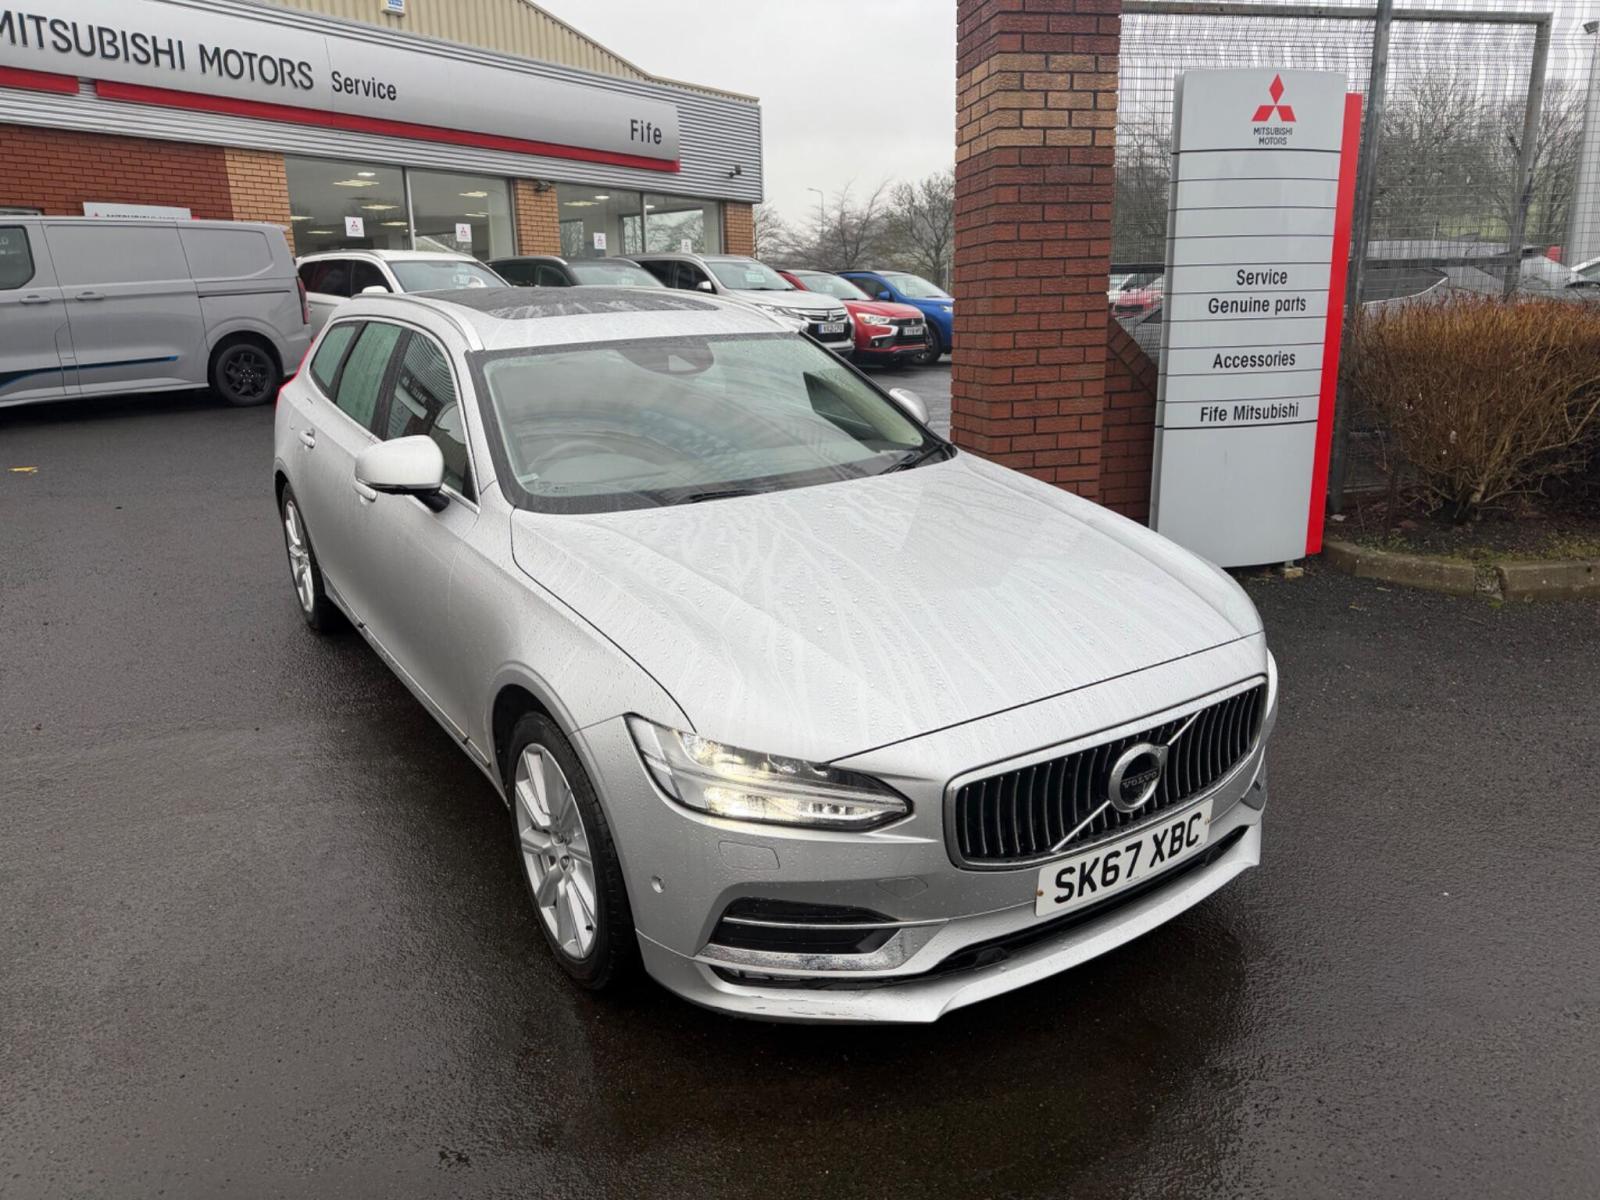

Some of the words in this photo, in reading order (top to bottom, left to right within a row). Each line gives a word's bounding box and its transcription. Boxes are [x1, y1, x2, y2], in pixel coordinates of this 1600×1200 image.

[199, 44, 314, 91] MOTORS
[331, 70, 397, 101] Service
[630, 119, 662, 145] Fife
[1253, 127, 1293, 136] MITSUBISHI
[1258, 136, 1288, 146] MOTORS
[1236, 269, 1288, 286] Service
[1208, 297, 1270, 314] Genuine
[1275, 296, 1306, 315] parts
[1213, 350, 1296, 369] Accessories
[1200, 405, 1227, 422] Fife
[1233, 402, 1300, 421] Mitsubishi
[1122, 771, 1158, 789] VOLVO
[1053, 840, 1143, 905] SK67
[1149, 812, 1203, 869] XBC
